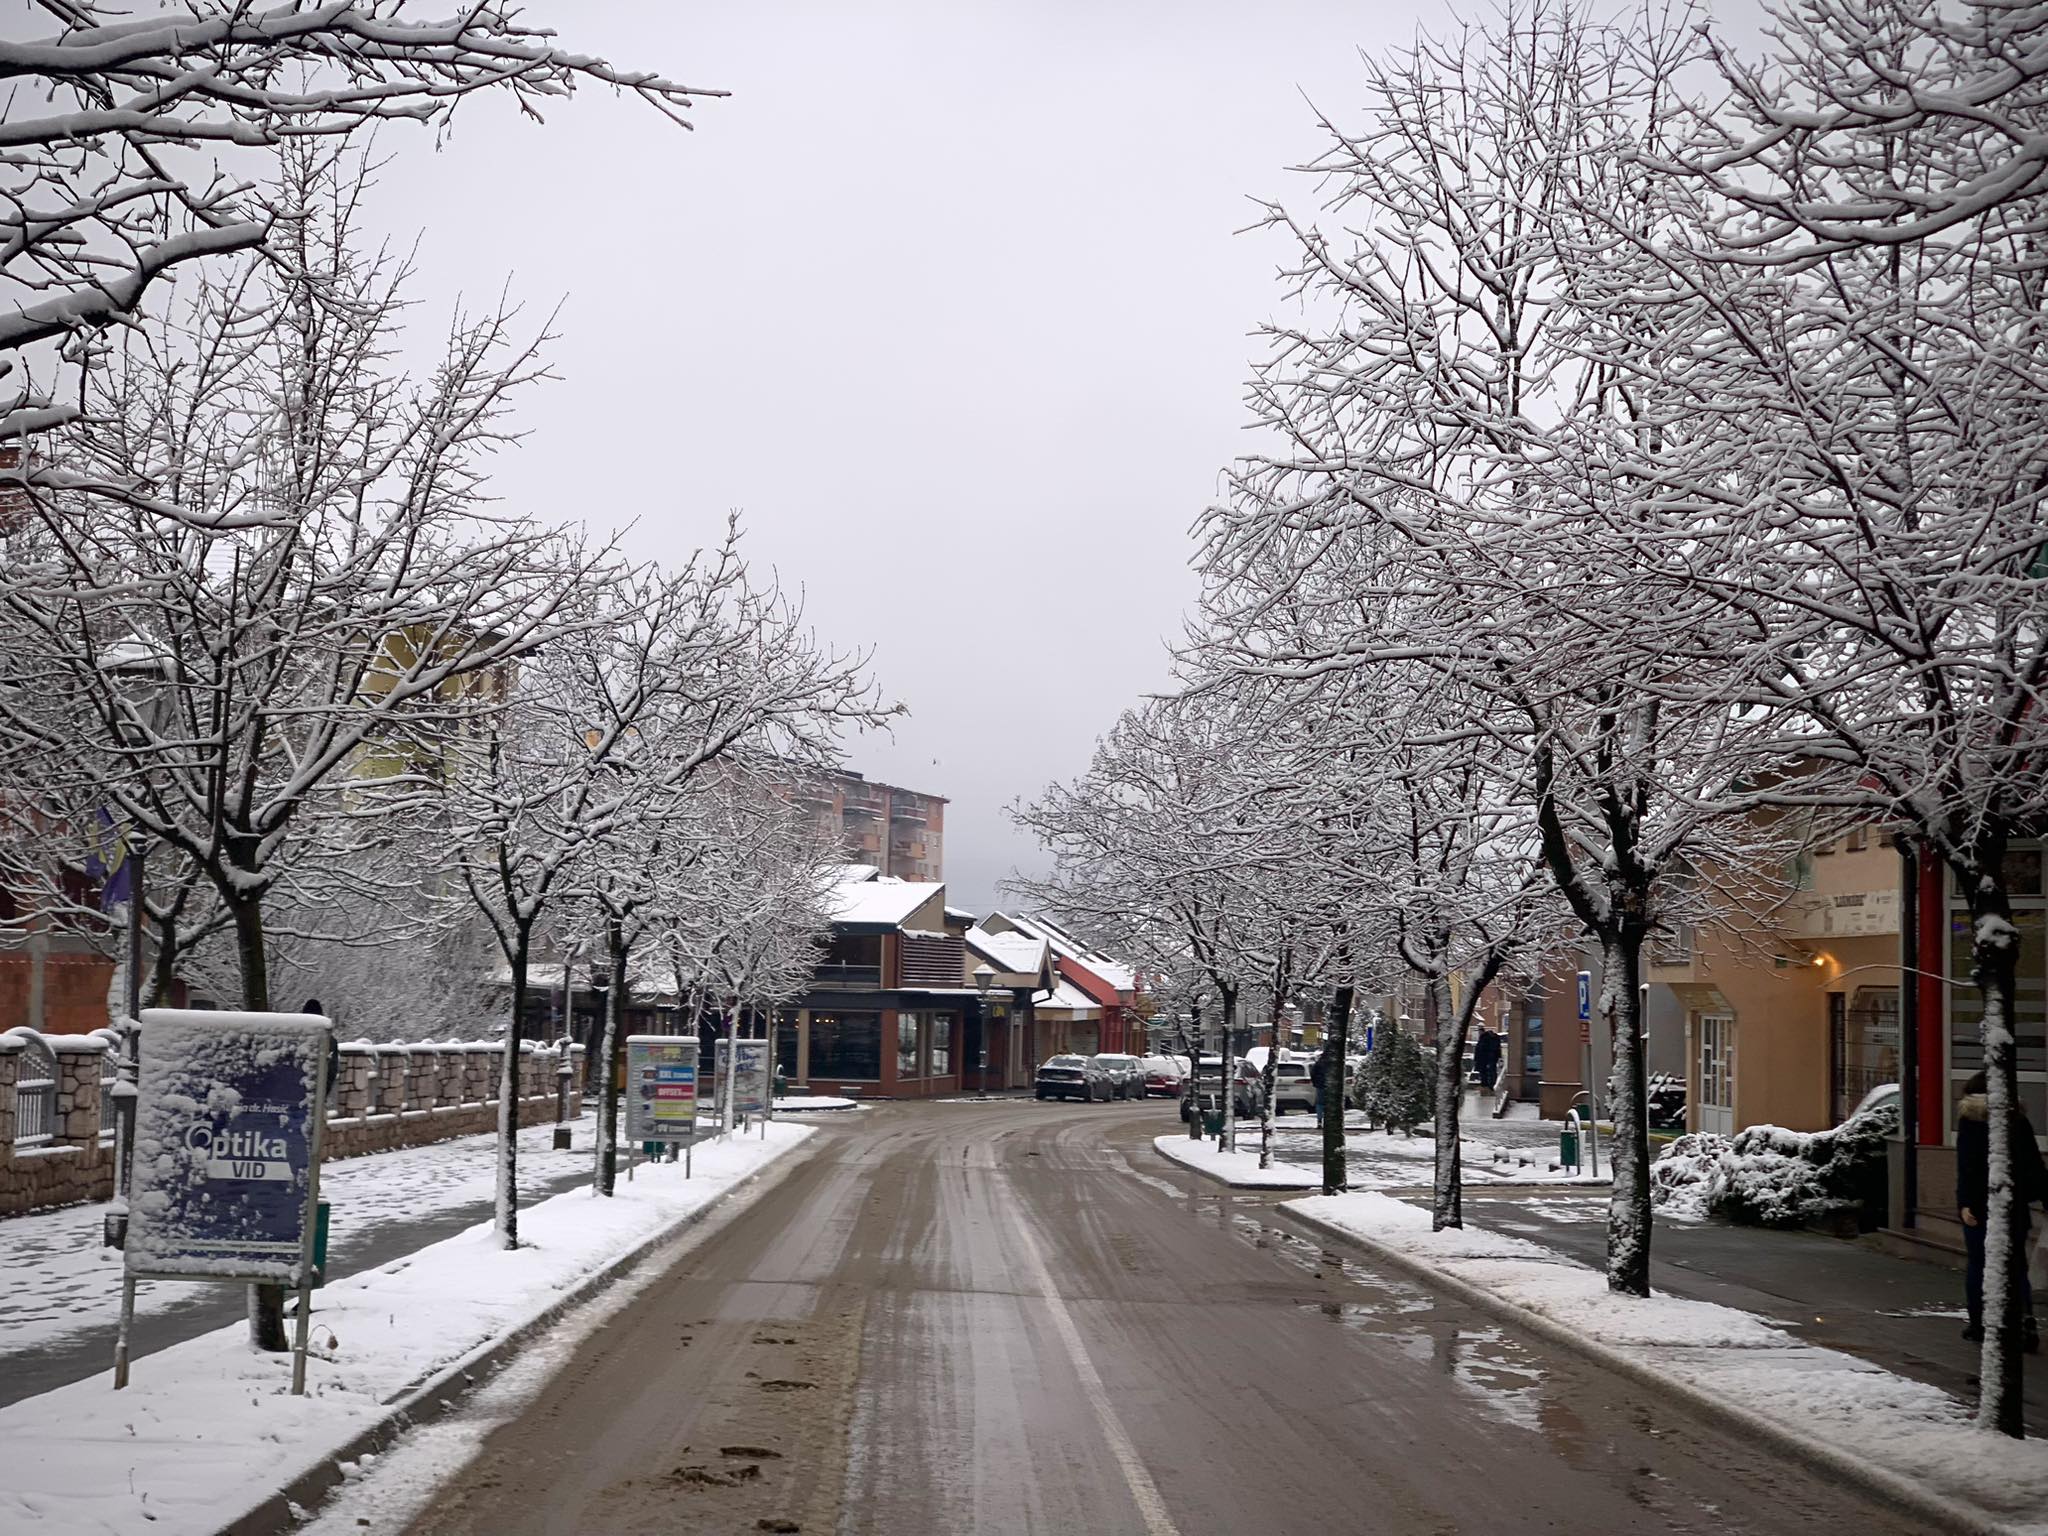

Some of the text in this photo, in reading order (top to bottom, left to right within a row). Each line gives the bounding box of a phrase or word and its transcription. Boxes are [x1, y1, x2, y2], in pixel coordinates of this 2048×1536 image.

[1579, 980, 1587, 1014] P
[185, 1121, 287, 1160] Optika
[232, 1161, 265, 1178] VID
